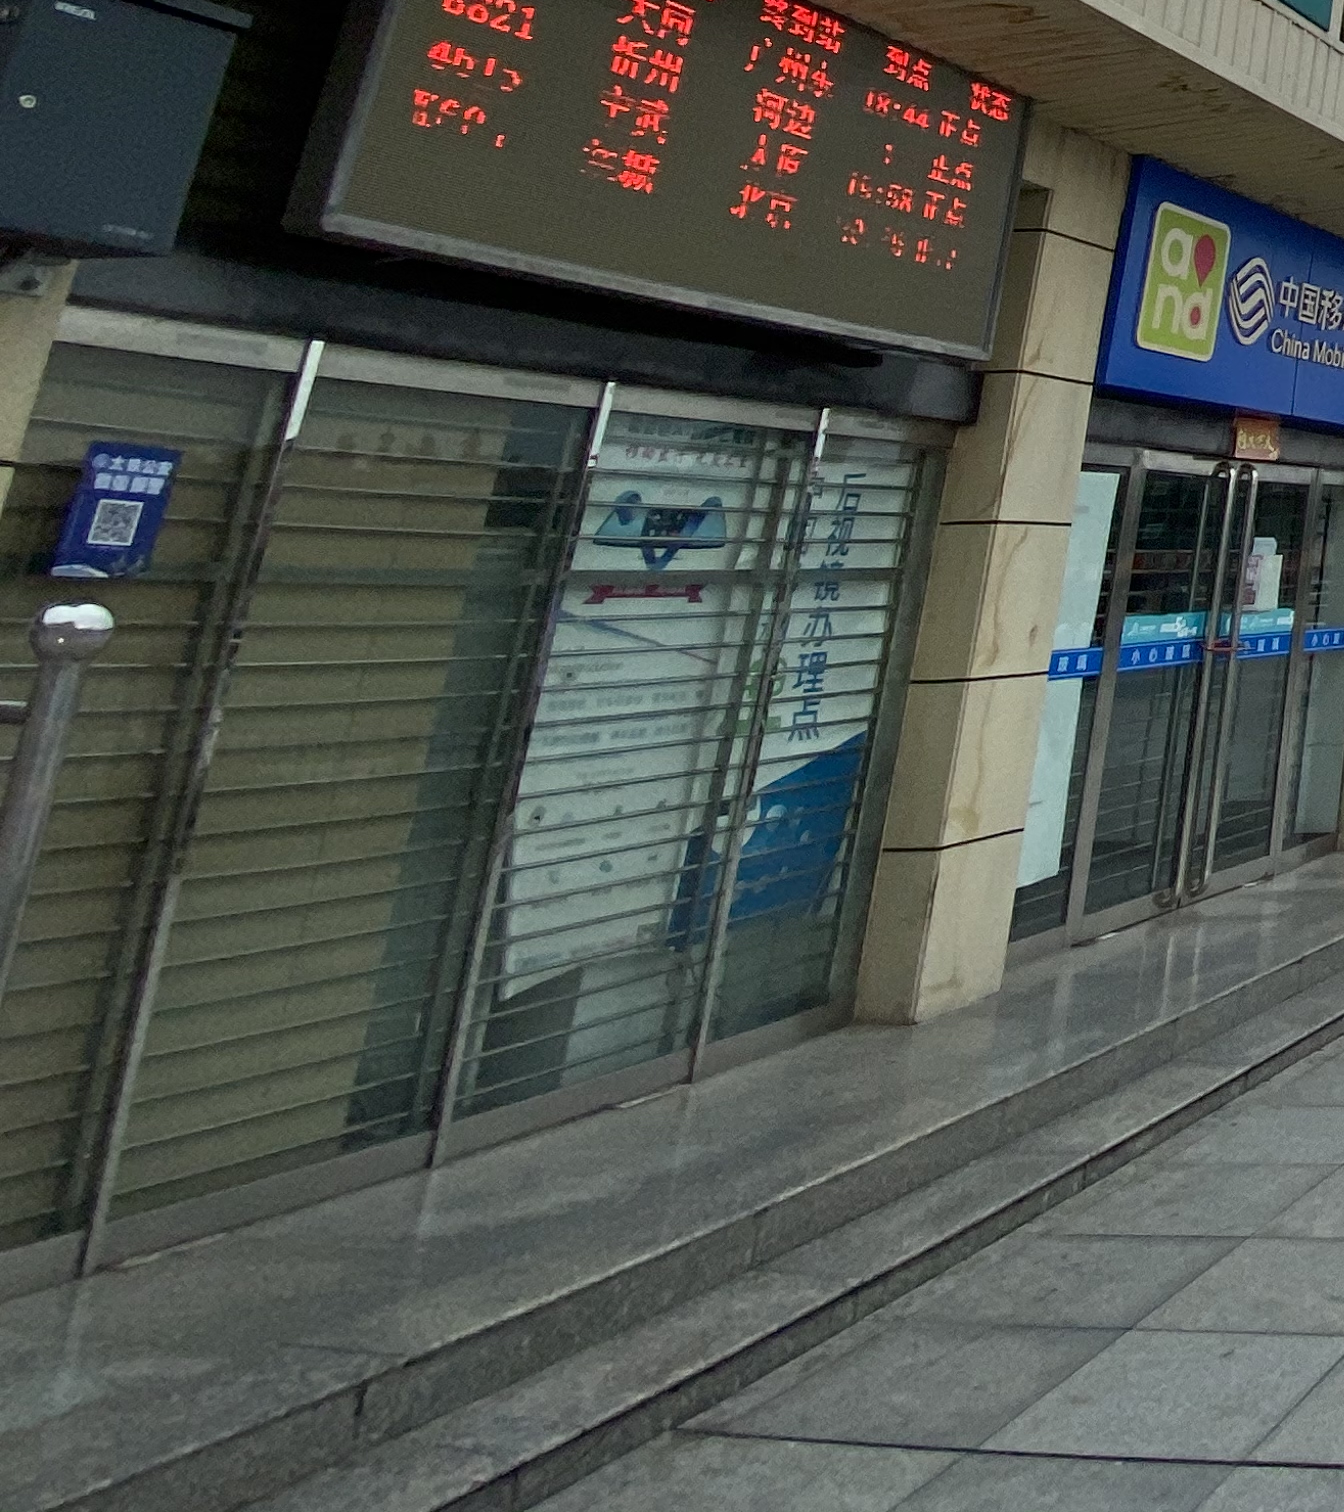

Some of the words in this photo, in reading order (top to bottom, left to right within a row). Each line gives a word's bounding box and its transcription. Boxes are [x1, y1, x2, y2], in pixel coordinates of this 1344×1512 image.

[610, 36, 684, 93] 忻州
[883, 43, 933, 91] 到点
[1270, 328, 1310, 361] China
